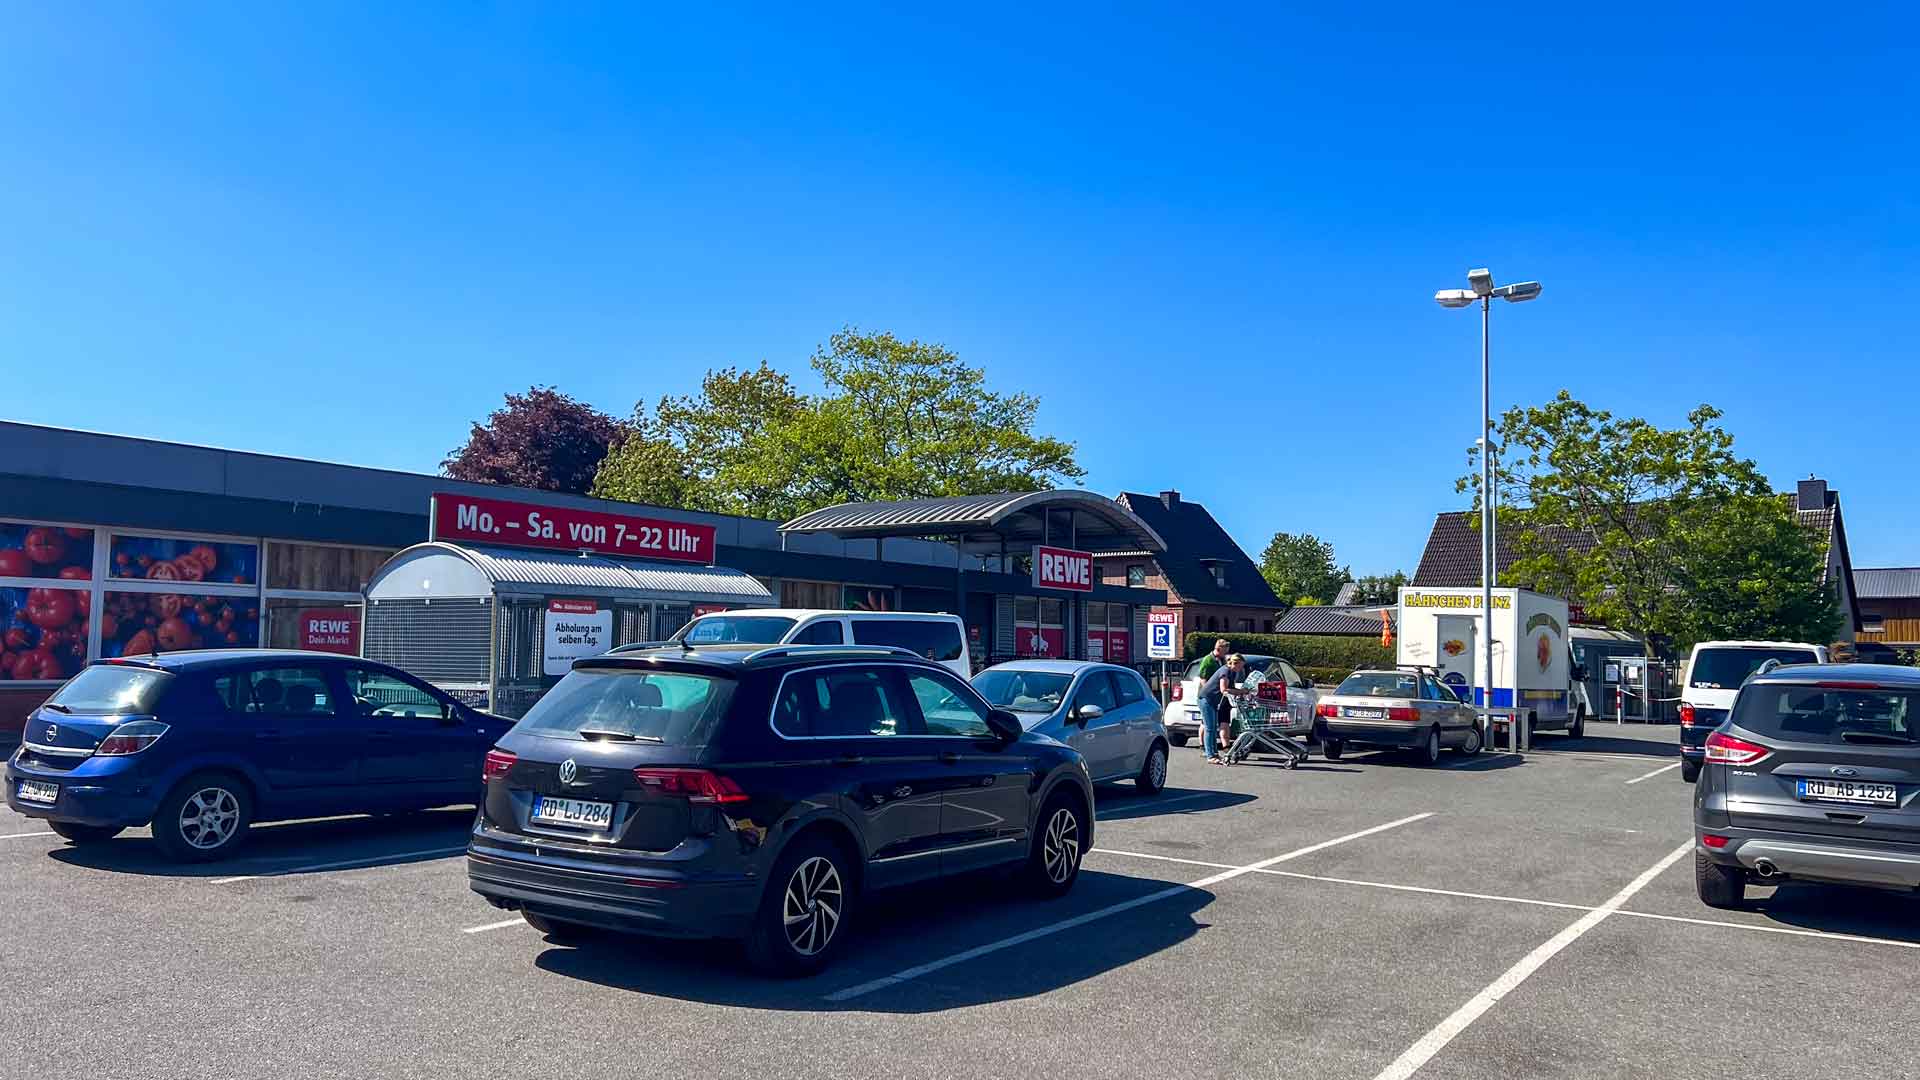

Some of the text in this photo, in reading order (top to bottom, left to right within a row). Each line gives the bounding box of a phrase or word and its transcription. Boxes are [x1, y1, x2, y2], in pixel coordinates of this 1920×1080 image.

[457, 503, 500, 534] Mo.
[527, 511, 561, 540] Sa.
[568, 522, 606, 544] von
[668, 528, 700, 553] Uhr
[1042, 553, 1090, 585] REWE
[1404, 592, 1512, 609] HÄHNCHEN PINZ
[1149, 613, 1174, 622] REWE
[310, 619, 350, 633] REWE
[555, 623, 602, 636] Abholung am
[309, 635, 349, 645] Dein Markt
[558, 634, 598, 646] selben Tag.
[1807, 780, 1895, 800] RD AB 1252
[541, 798, 610, 824] RD LJ 284
